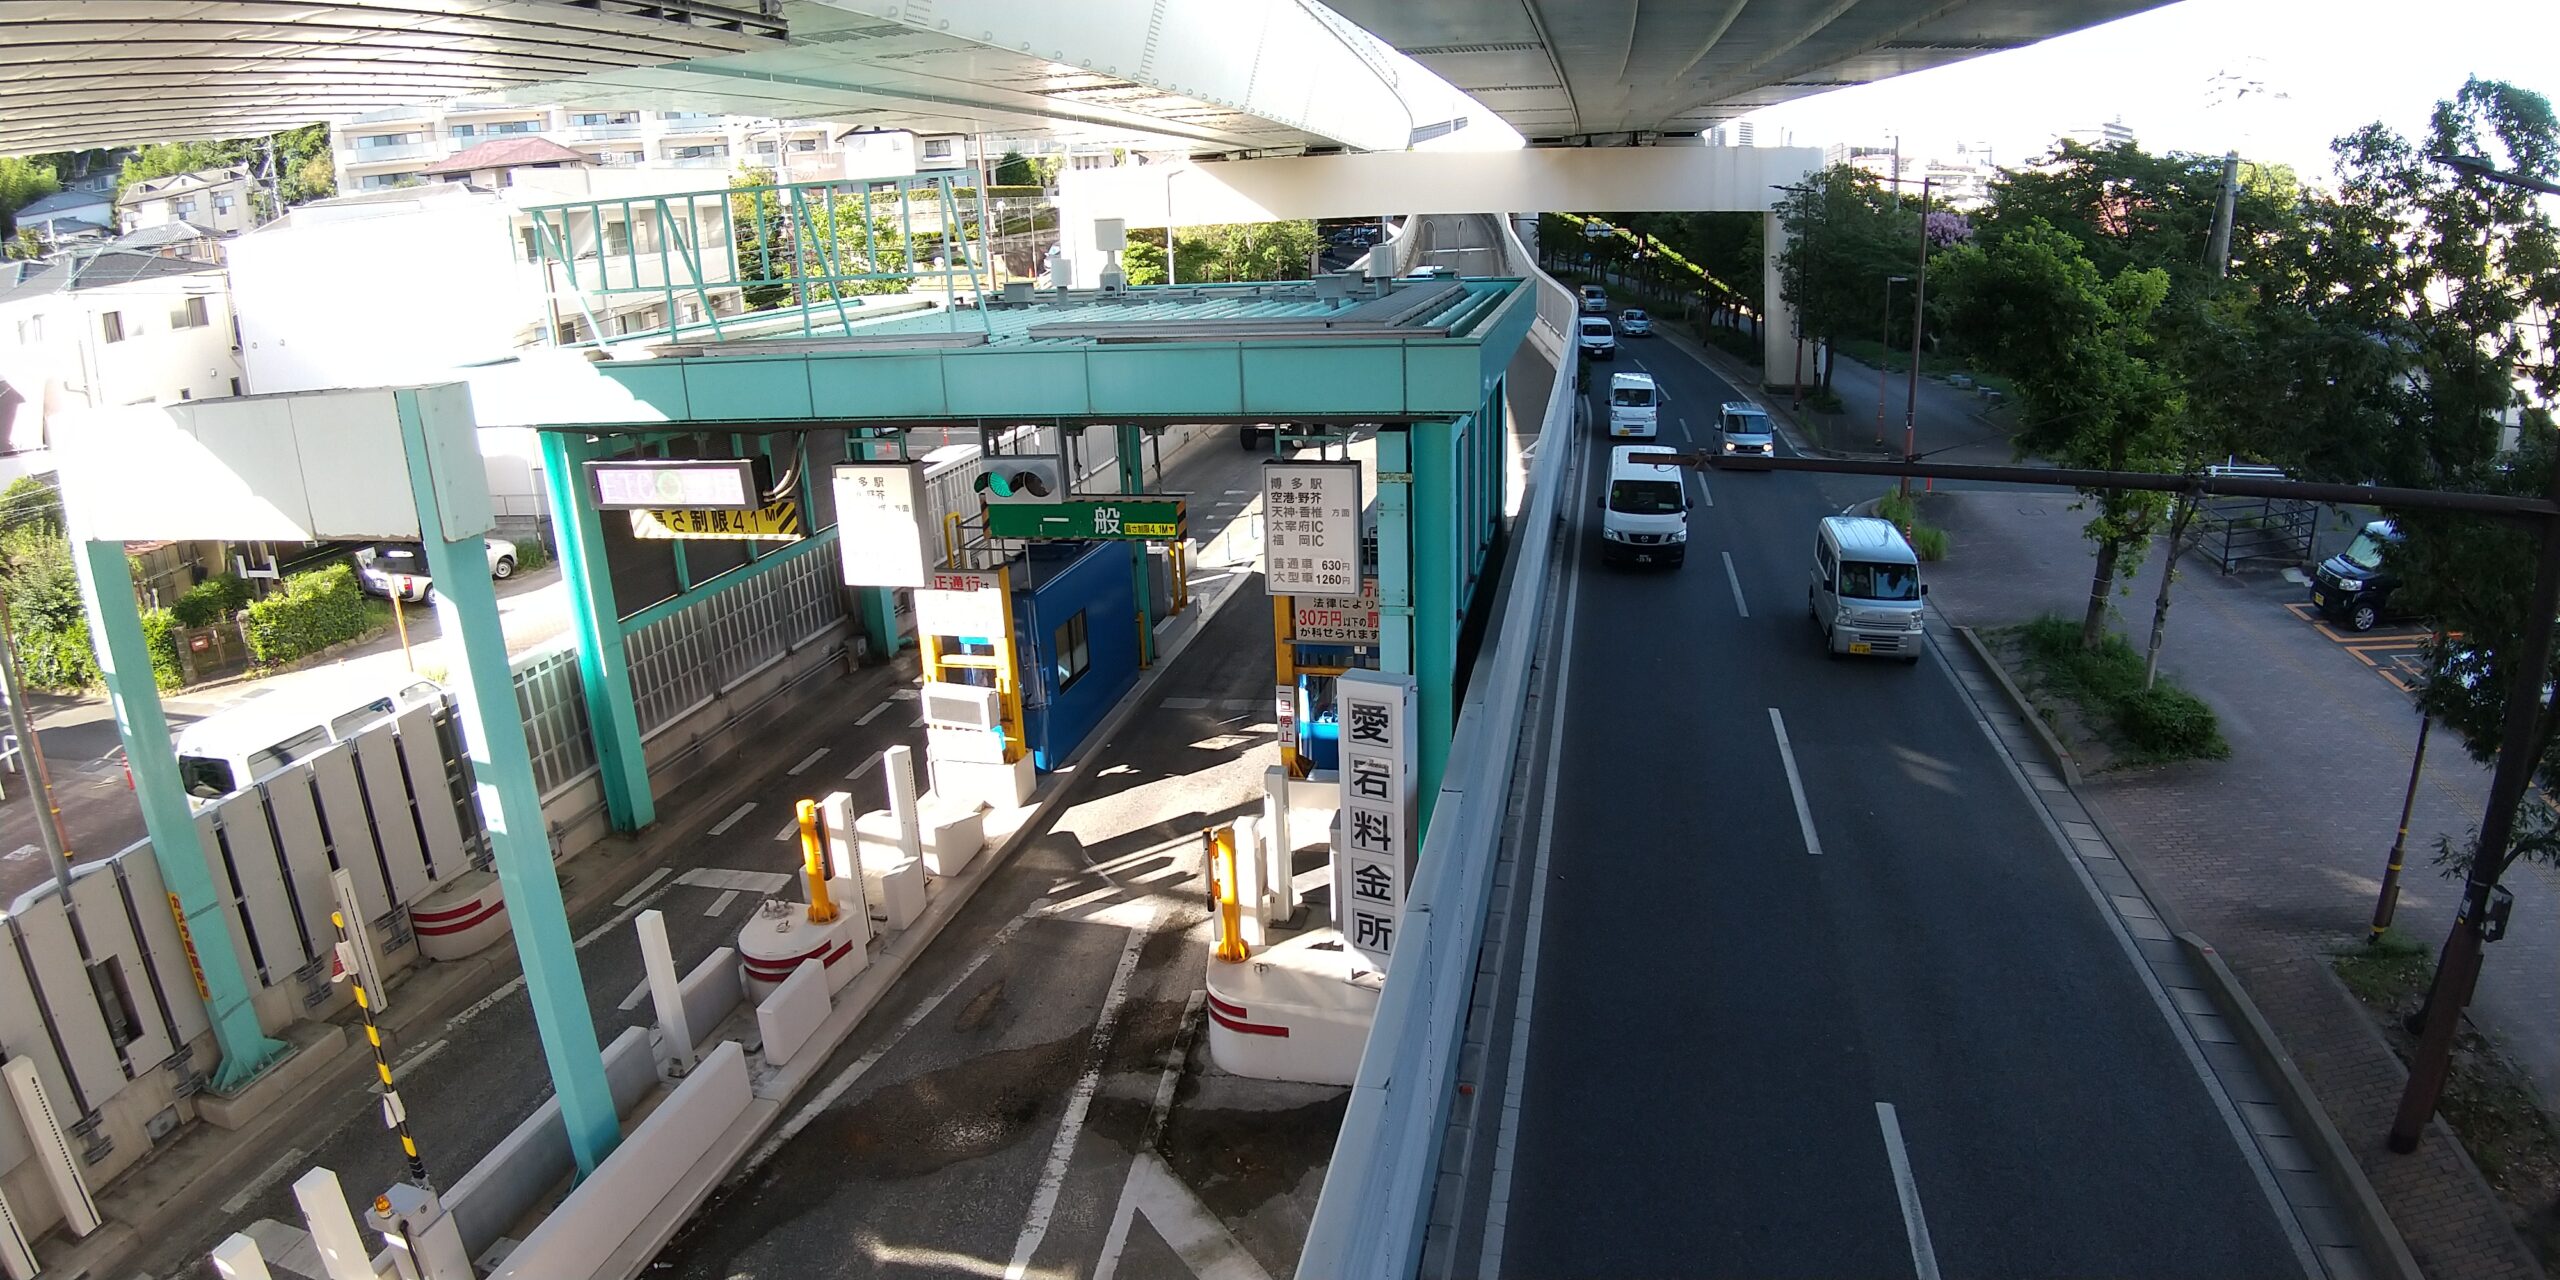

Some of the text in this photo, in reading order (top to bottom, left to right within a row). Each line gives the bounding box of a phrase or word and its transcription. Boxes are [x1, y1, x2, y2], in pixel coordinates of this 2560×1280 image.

[1270, 477, 1322, 490] 博多駅
[1331, 509, 1350, 517] 方面
[1042, 506, 1122, 535] 一般
[1272, 520, 1324, 533] 太宰府IC
[1272, 534, 1324, 547] 福岡IC
[1273, 557, 1350, 571] 普通車 630円
[929, 575, 990, 592] 正通行は
[1273, 572, 1350, 585] 大型車 1260円
[1313, 597, 1375, 609] 法律により
[1300, 627, 1380, 639] が科せられます
[1278, 691, 1294, 743] 一旦停止
